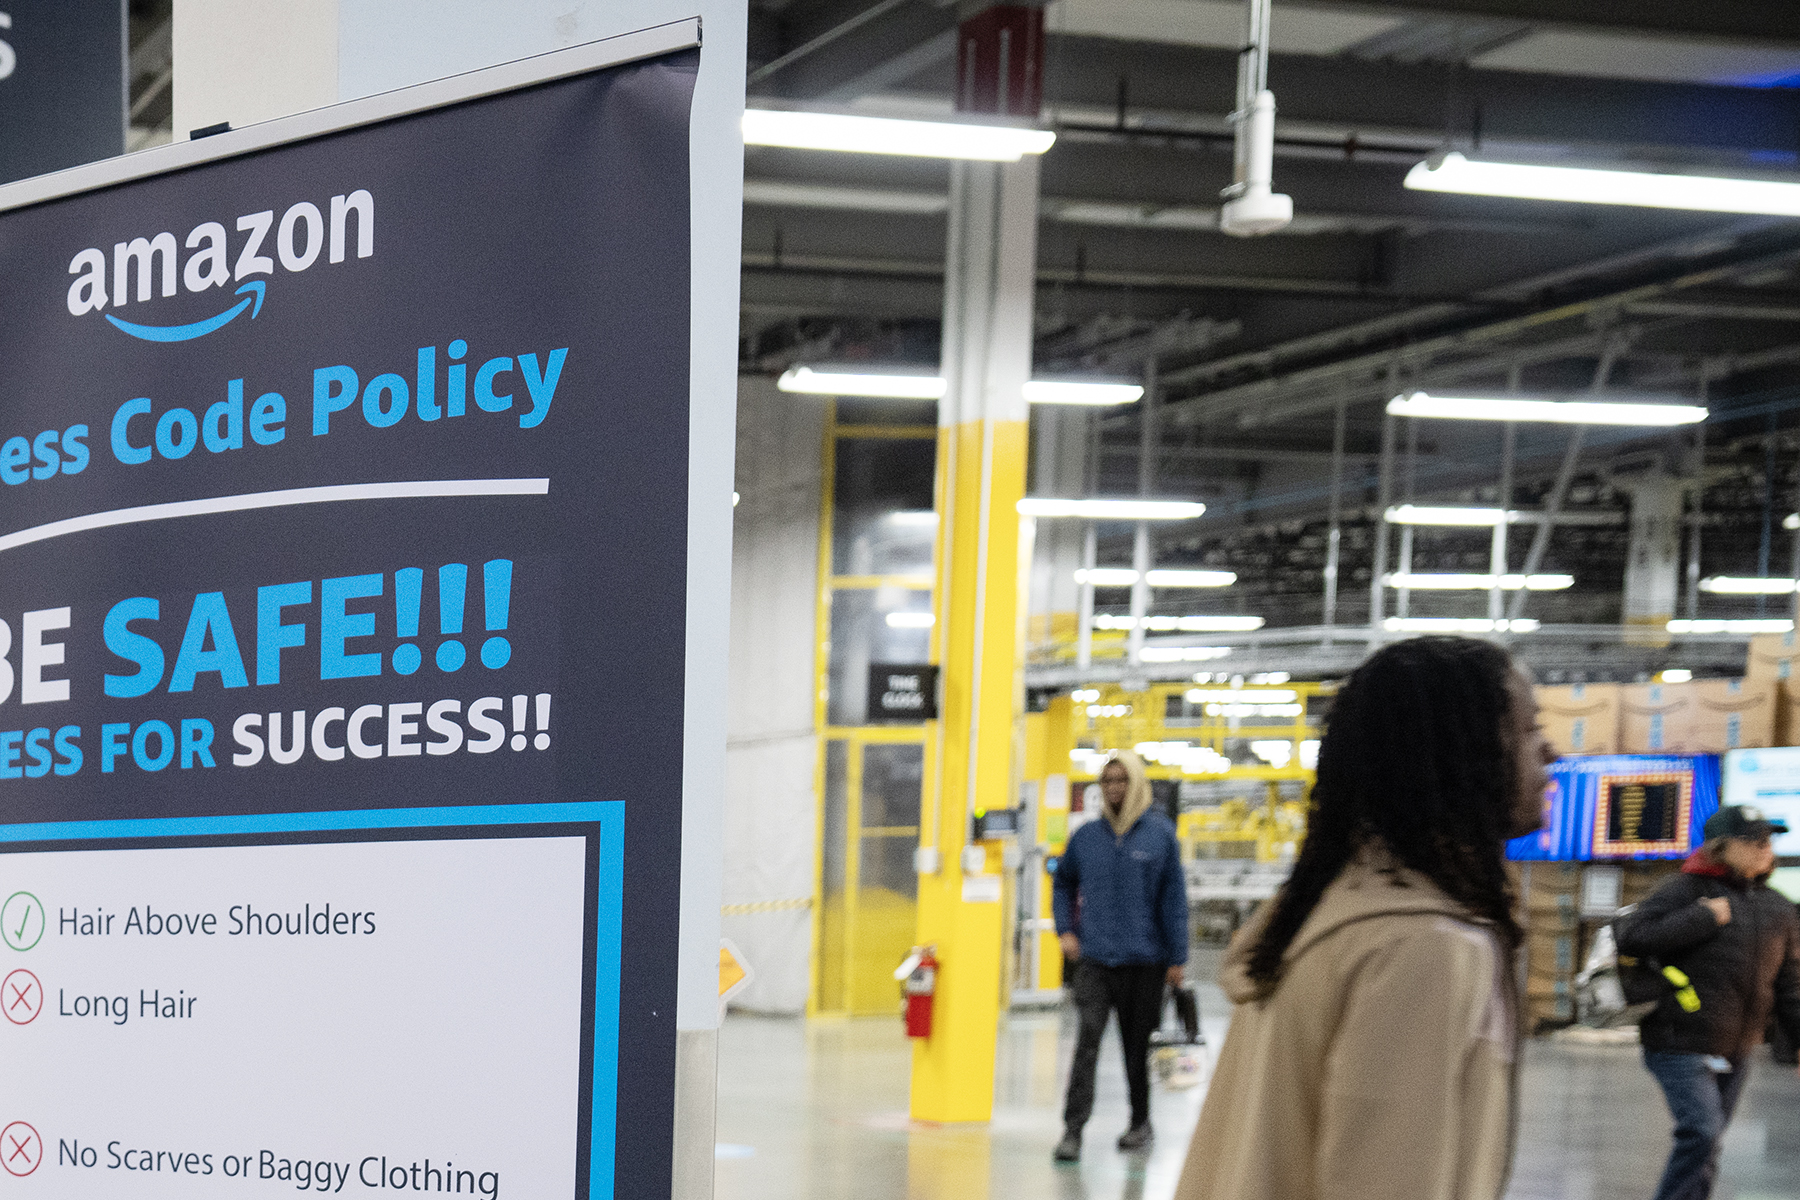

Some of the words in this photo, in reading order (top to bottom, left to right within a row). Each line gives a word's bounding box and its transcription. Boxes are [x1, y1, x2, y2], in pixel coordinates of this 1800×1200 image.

[66, 189, 375, 316] amazon
[110, 378, 286, 465] Code
[312, 339, 569, 436] Policy
[102, 558, 513, 699] SAFE!!!
[101, 718, 216, 773] FOR
[232, 693, 552, 767] SUCCESS!!
[59, 907, 116, 936] Hair
[123, 904, 218, 936] Above
[228, 902, 377, 936] Shoulders
[59, 988, 129, 1026] Long
[139, 988, 198, 1019] Hair
[58, 1138, 98, 1169] No
[106, 1140, 214, 1176] Scarves
[222, 1154, 254, 1178] or
[258, 1149, 351, 1194] Baggy
